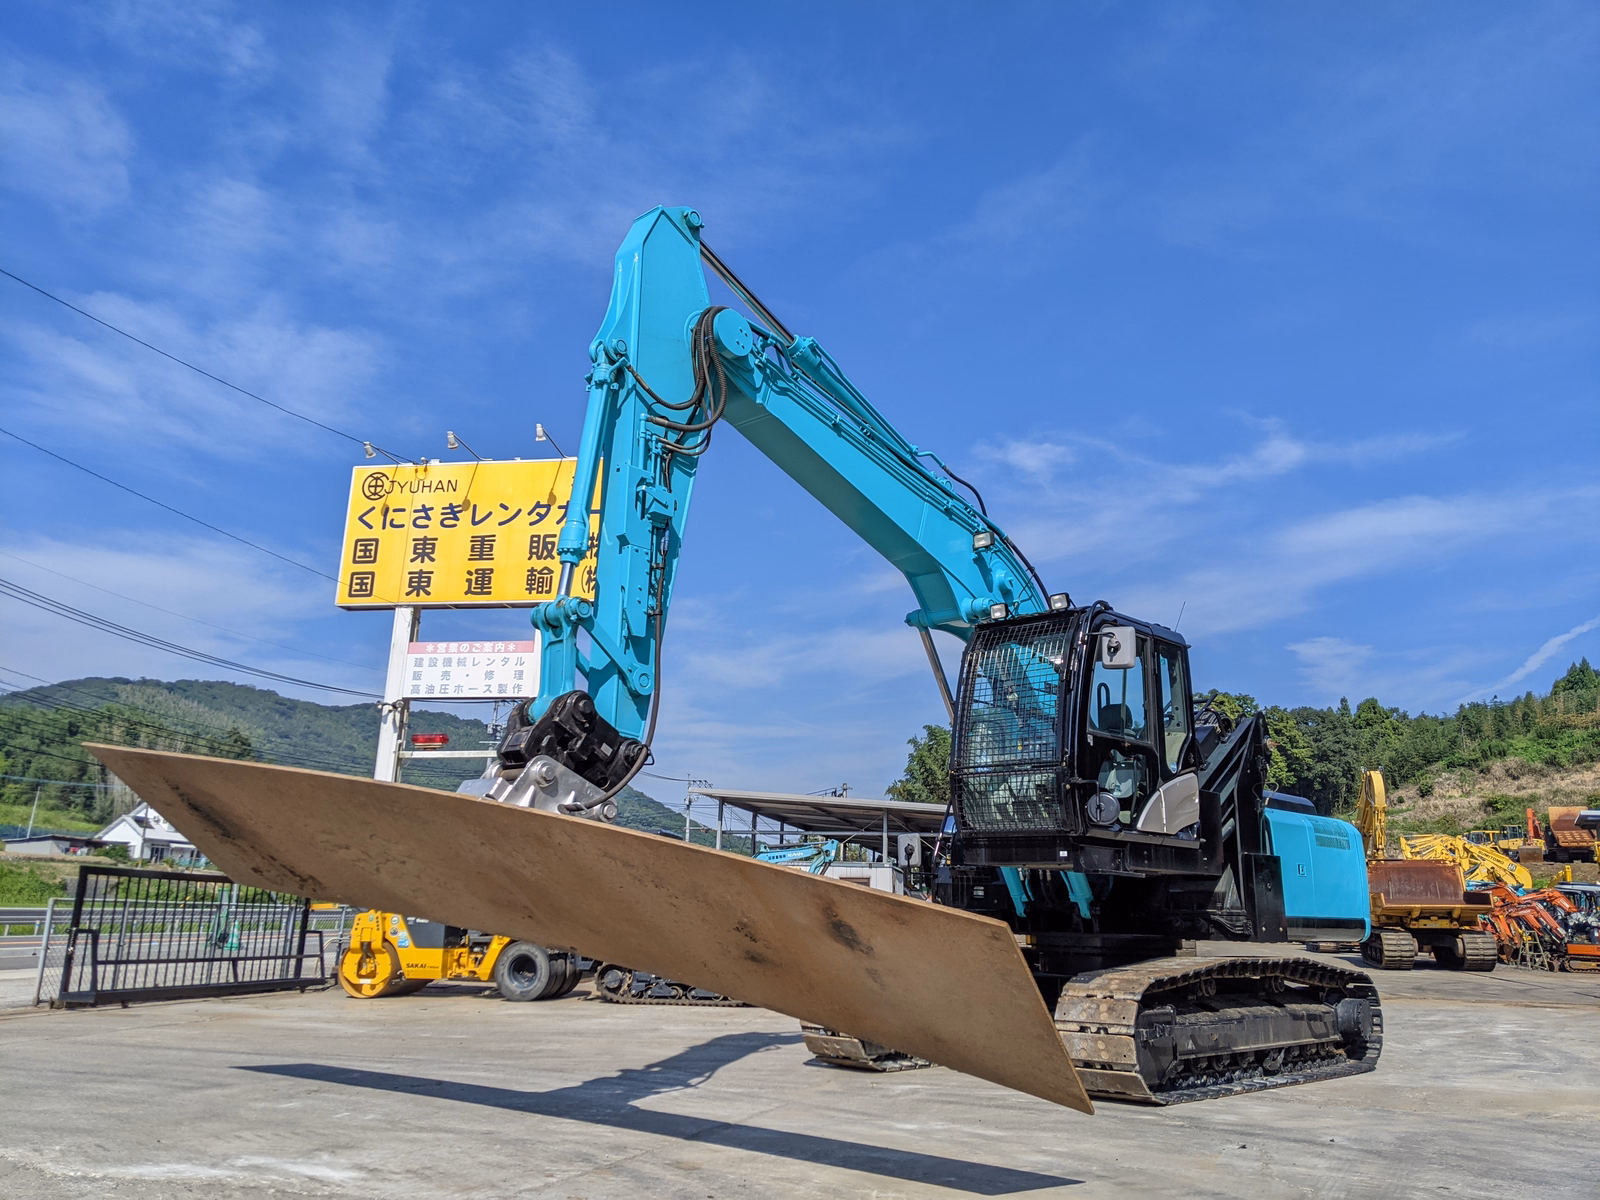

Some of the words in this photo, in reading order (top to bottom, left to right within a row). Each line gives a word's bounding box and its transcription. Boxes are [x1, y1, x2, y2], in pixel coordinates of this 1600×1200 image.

[384, 479, 458, 494] JYUHAN
[413, 656, 526, 668] 建設機械レンタル
[410, 682, 523, 695] 高油圧ホース製作
